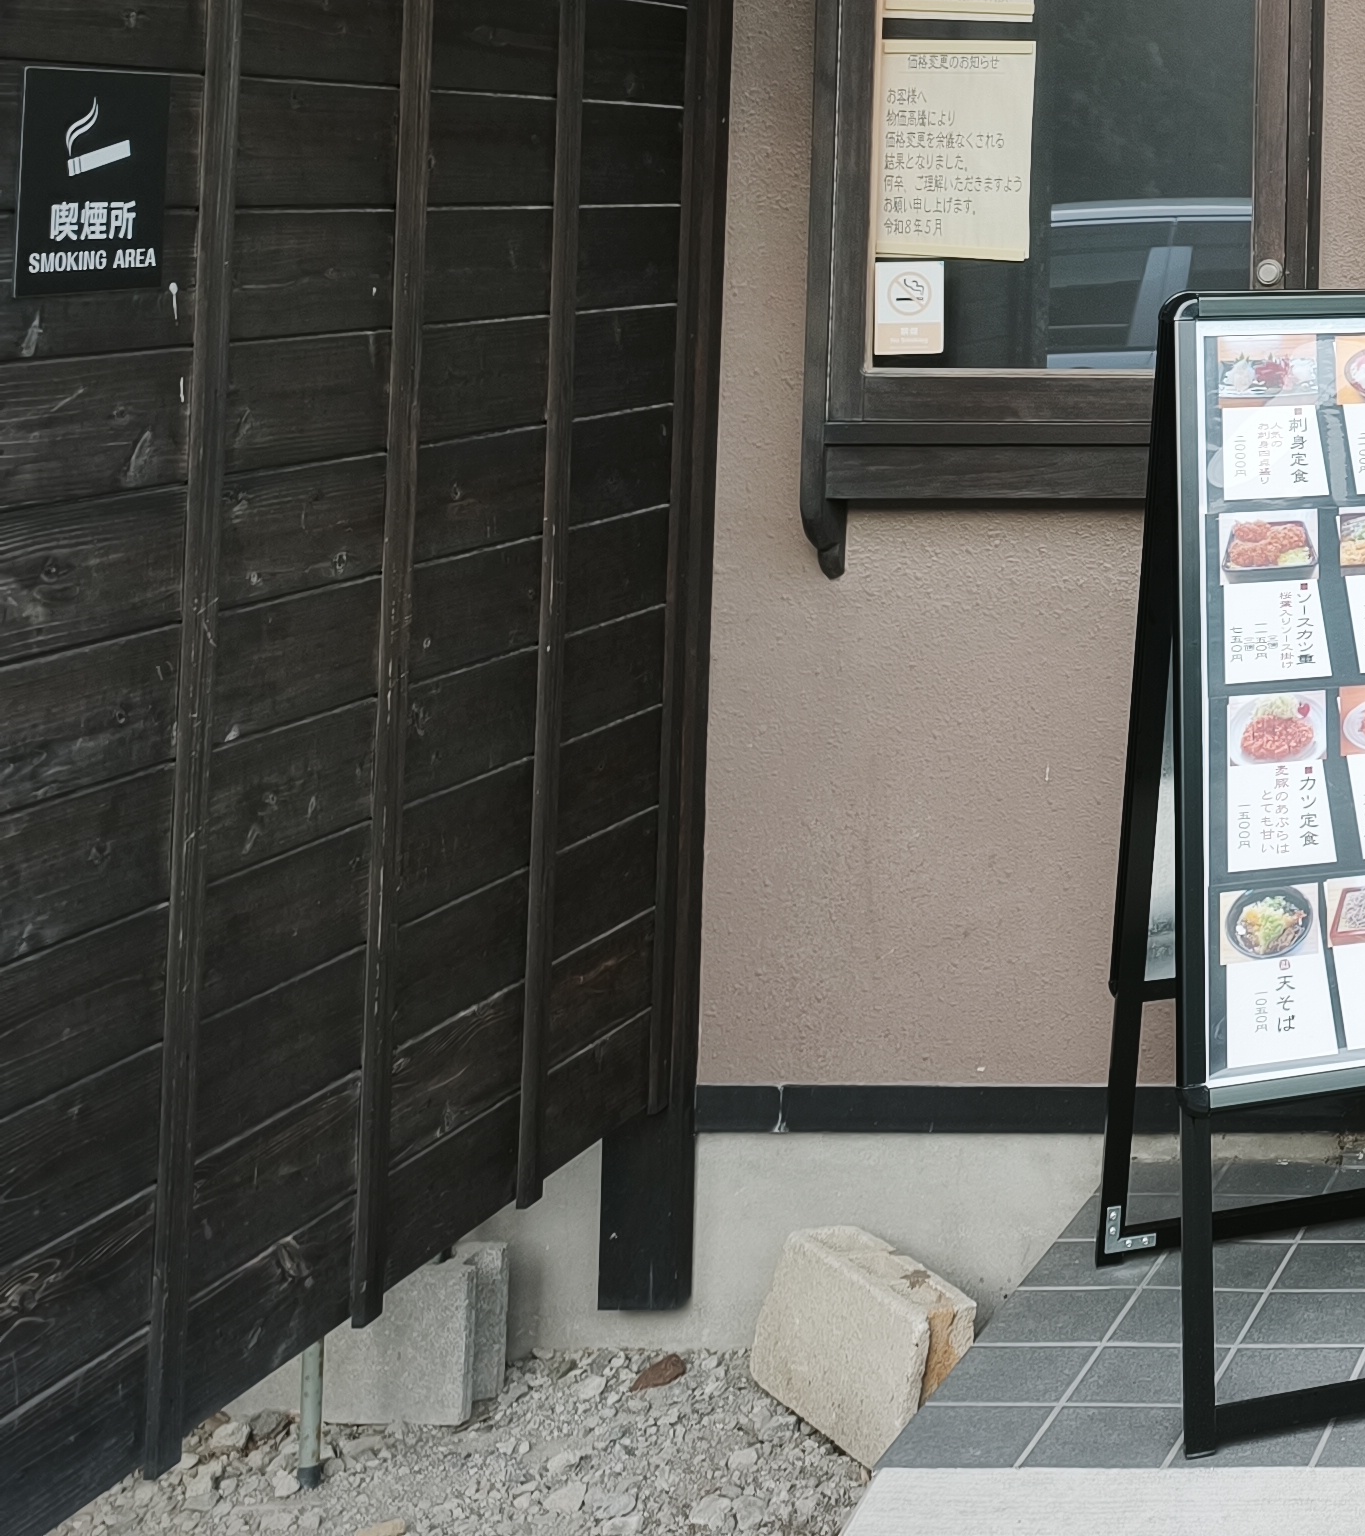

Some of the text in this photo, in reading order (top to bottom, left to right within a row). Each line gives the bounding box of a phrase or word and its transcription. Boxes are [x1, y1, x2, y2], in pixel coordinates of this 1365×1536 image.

[907, 54, 1000, 70] 価格変更のお知らせ
[886, 87, 927, 105] お客様へ
[885, 132, 1005, 149] 価格変更を余儀なくされる
[884, 152, 969, 172] 結果となりました。
[884, 175, 1023, 193] 何卒、ご理解いただきますよう
[884, 196, 976, 215] お願い申し上げます。
[49, 200, 136, 242] 喫煙所
[28, 247, 157, 274] SMOKING AREA
[1270, 421, 1284, 448] 人気の
[1288, 417, 1310, 484] 刺身定食
[1296, 592, 1316, 666] ソースカツ重
[1259, 789, 1275, 854] とても甘い
[1299, 775, 1320, 848] カツ定食
[1275, 975, 1296, 1033] 天そば
